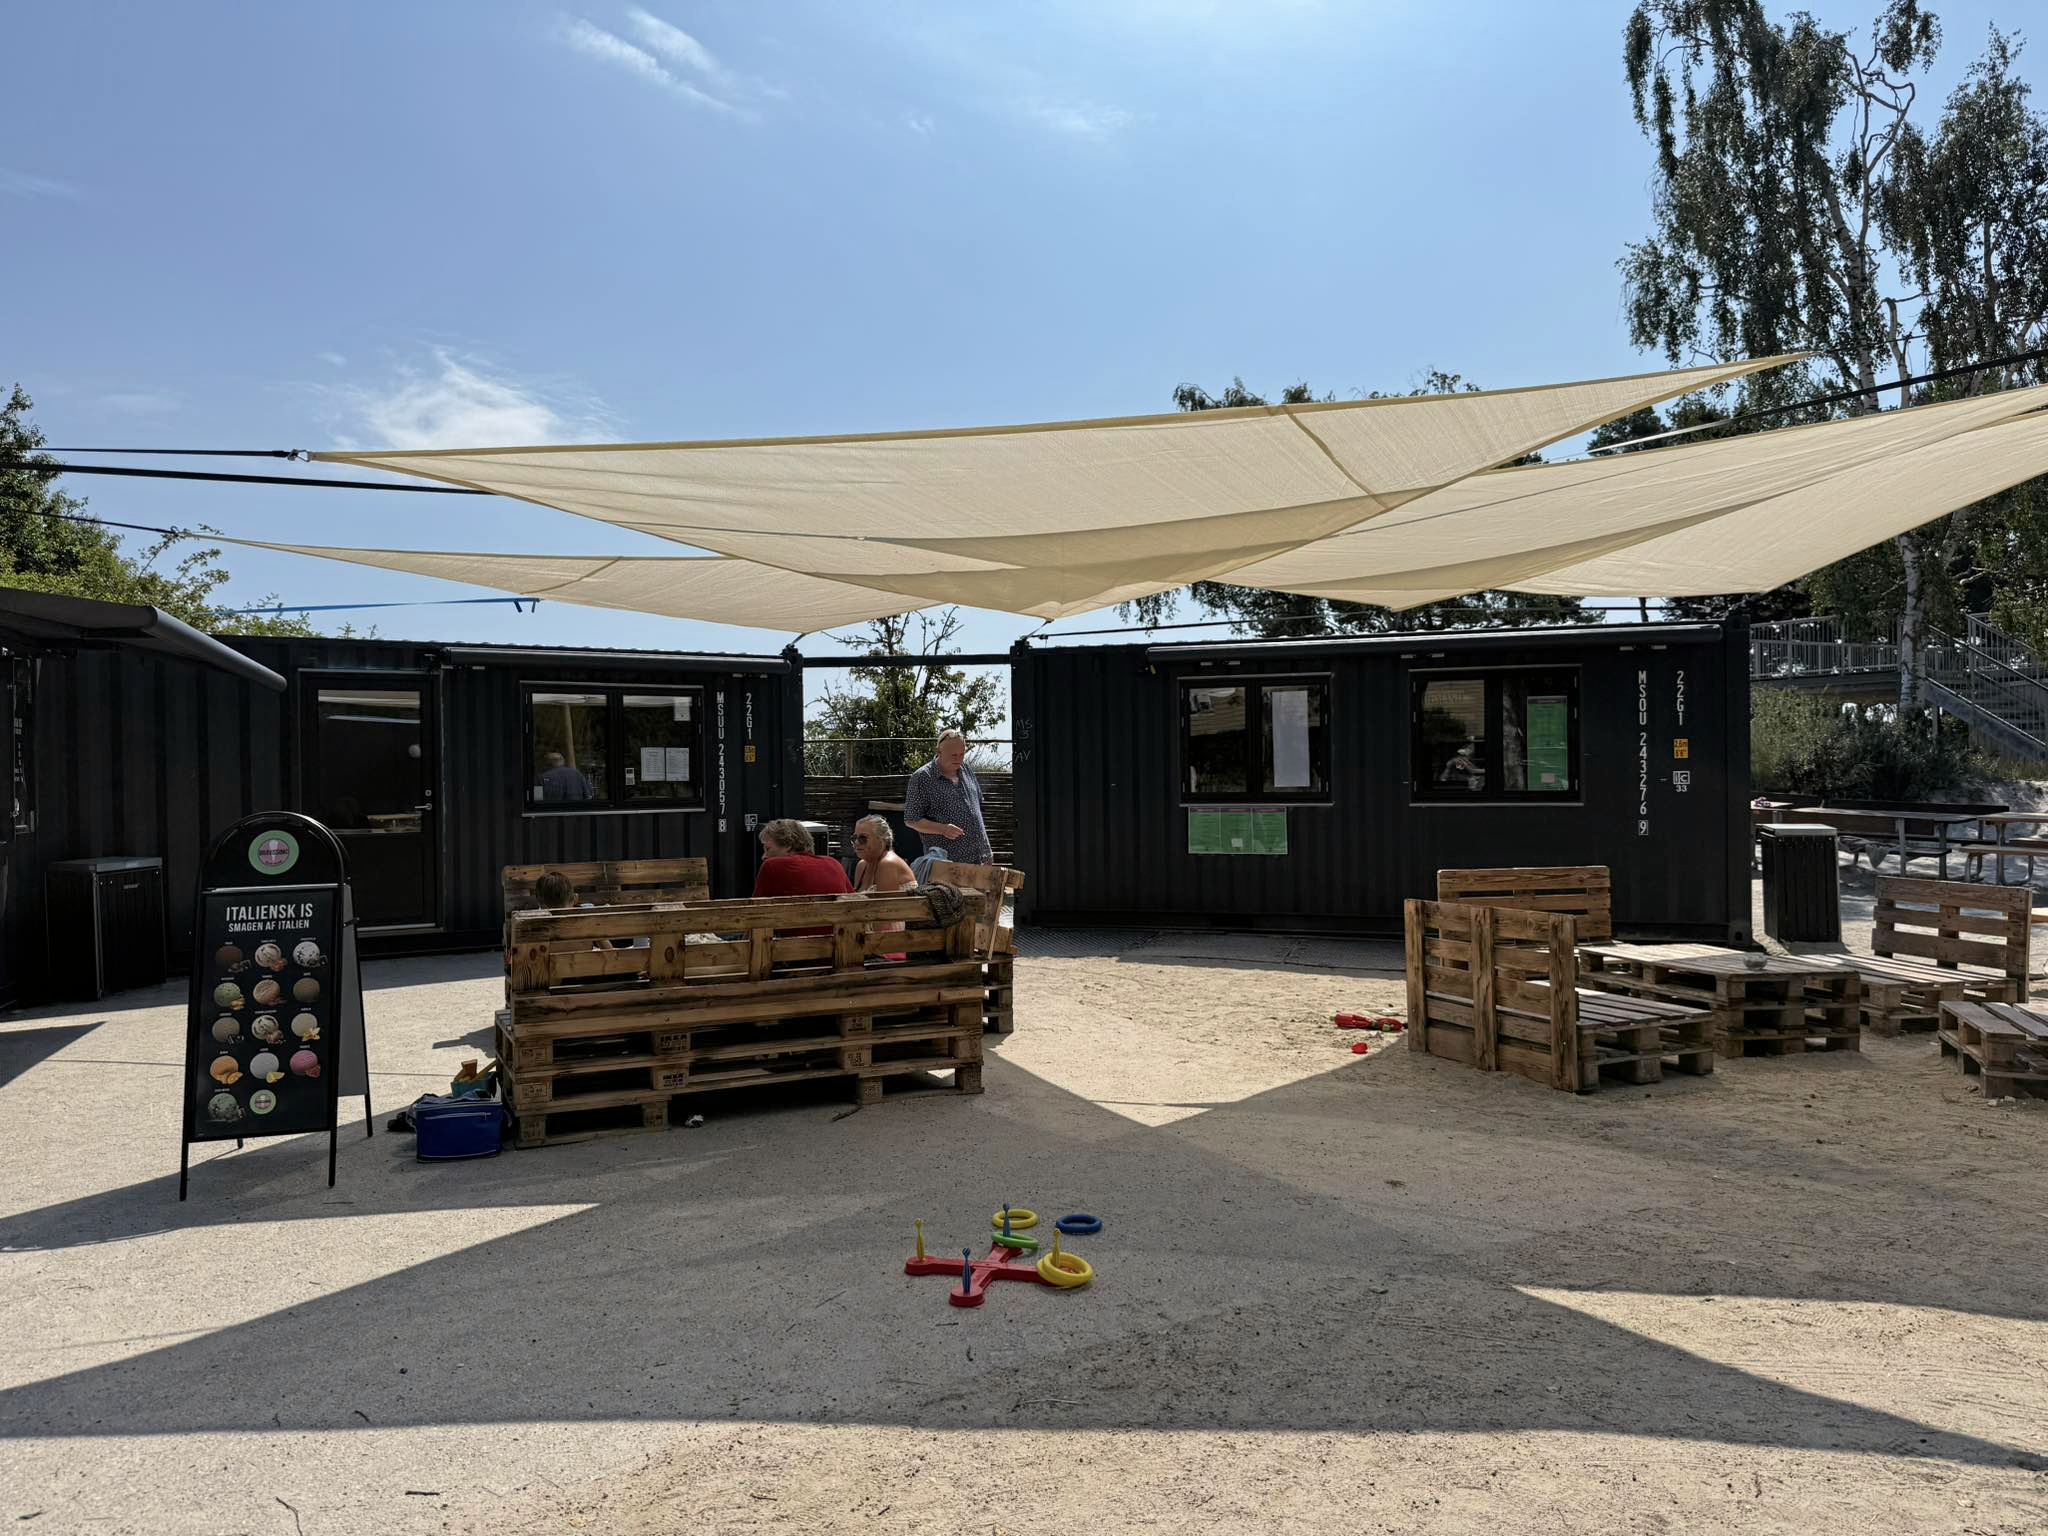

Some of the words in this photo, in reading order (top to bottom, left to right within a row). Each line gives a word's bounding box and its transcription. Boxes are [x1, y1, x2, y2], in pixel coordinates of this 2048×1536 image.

[716, 691, 725, 740] MSUU
[1638, 670, 1647, 726] MSOU
[1676, 670, 1685, 726] 22G1
[718, 743, 726, 815] 243057
[1639, 732, 1647, 815] 243276
[719, 819, 727, 832] 8
[1639, 820, 1648, 835] 9
[225, 904, 296, 921] ITALIENSK
[301, 903, 313, 918] IS
[228, 922, 263, 932] SMAGEN
[265, 921, 277, 930] AF
[278, 920, 309, 930] ITALIEN
